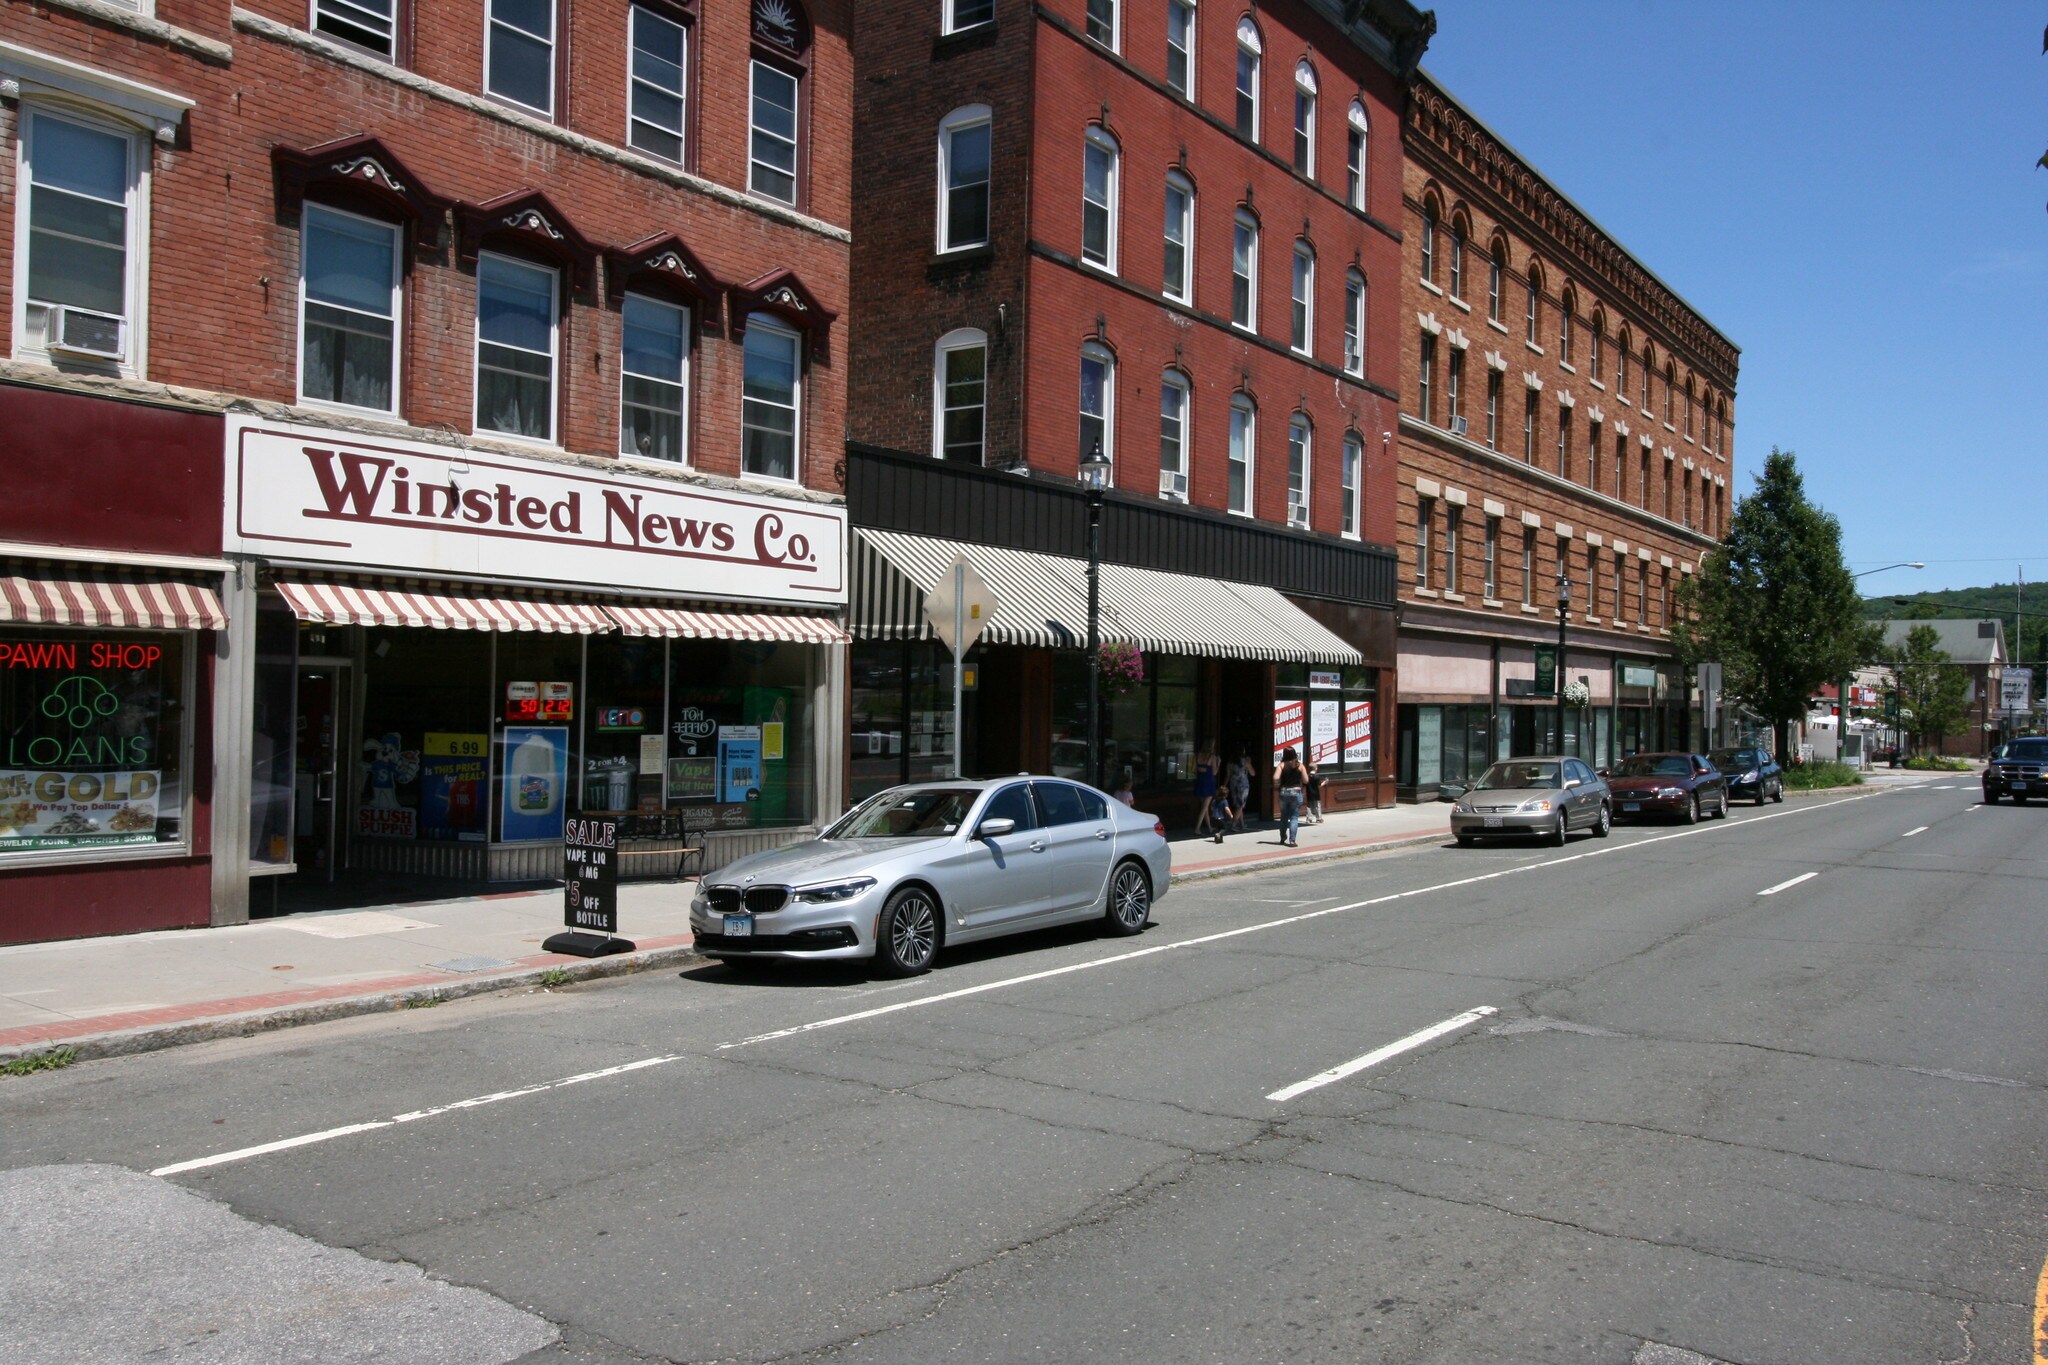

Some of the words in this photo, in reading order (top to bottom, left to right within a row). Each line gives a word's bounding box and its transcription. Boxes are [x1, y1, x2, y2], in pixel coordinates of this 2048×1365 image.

[302, 446, 582, 535] Winsted
[602, 490, 735, 552] News
[754, 513, 817, 565] Co.
[0, 642, 75, 669] PAWN
[90, 643, 161, 669] SHOP
[520, 700, 537, 712] 50
[598, 708, 642, 726] KENO
[1274, 726, 1285, 745] FOR
[1285, 720, 1303, 742] LEASE
[1345, 725, 1356, 743] FOR
[1355, 719, 1370, 739] LEASE
[9, 736, 148, 765] LOANS
[450, 742, 479, 754] 6.99
[425, 767, 432, 776] Is
[434, 765, 454, 775] THIS
[455, 762, 481, 772] PRICE
[588, 760, 596, 770] 2
[613, 755, 627, 765] $4
[443, 774, 457, 783] for
[458, 771, 486, 781] REAL?
[675, 763, 710, 778] Vape
[34, 773, 158, 803] GOLD
[670, 781, 690, 791] Sold
[694, 781, 714, 791] Here
[51, 804, 67, 812] Pay
[71, 803, 88, 812] Top
[91, 803, 121, 811] Dollar
[360, 809, 412, 824] SLUSH
[726, 817, 747, 826] SODA
[566, 819, 615, 849] SALE
[566, 848, 586, 862] VAPE
[592, 851, 606, 865] LIQ
[585, 866, 598, 879] MG
[583, 896, 599, 910] OFF
[576, 910, 608, 927] BOTTLE
